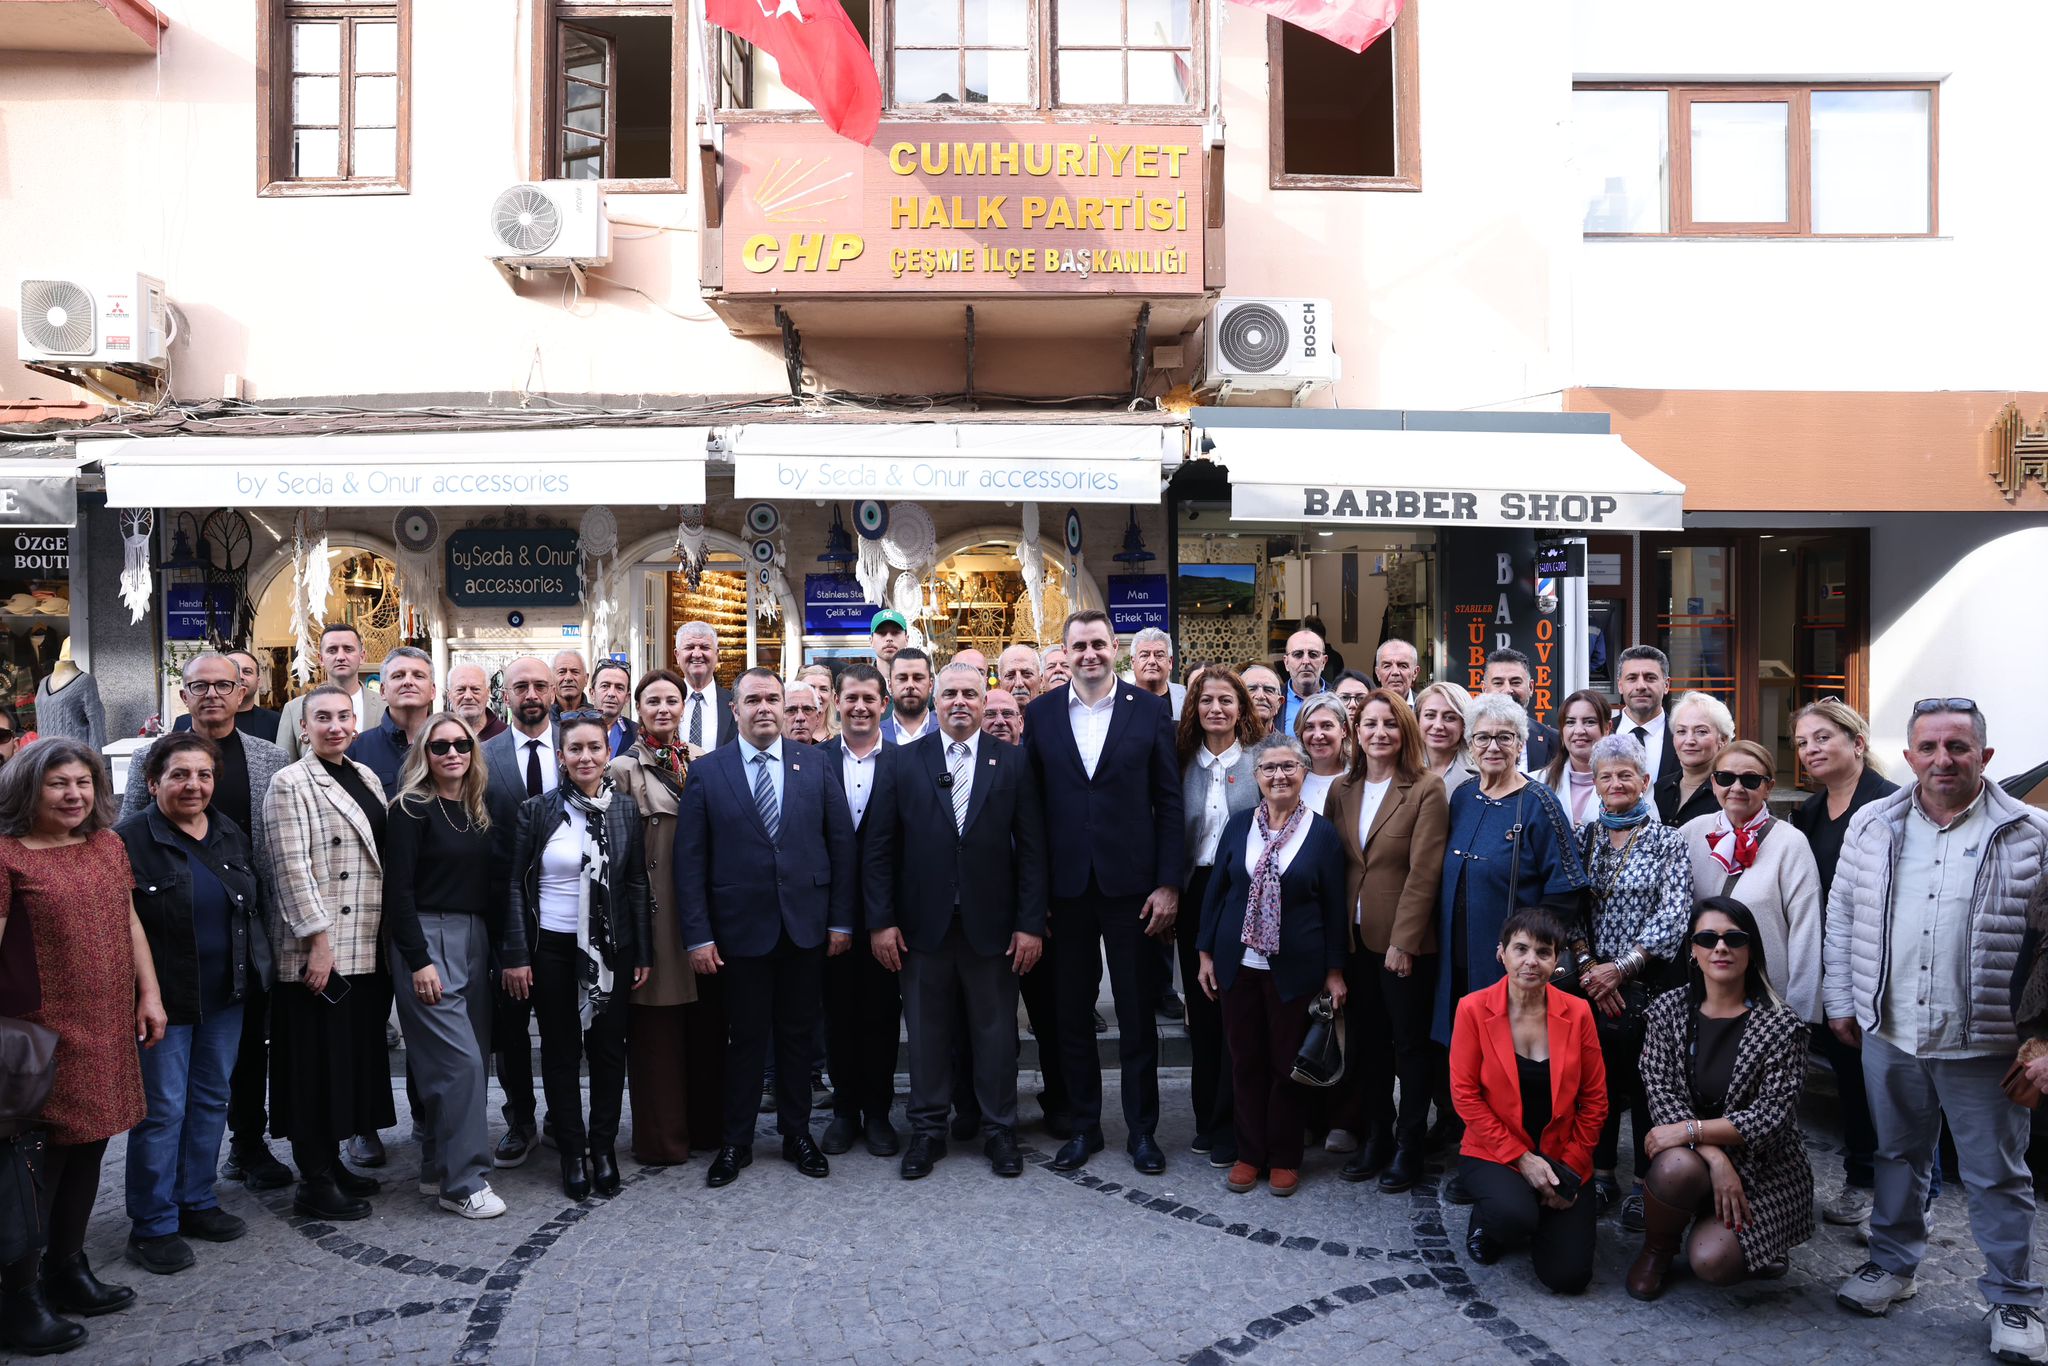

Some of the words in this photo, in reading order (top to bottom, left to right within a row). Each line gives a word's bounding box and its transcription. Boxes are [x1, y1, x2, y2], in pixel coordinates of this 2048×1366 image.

[889, 134, 1188, 177] CUMHURİYET
[891, 195, 1008, 229] HALK
[1022, 190, 1187, 231] PARTİSİ
[742, 233, 865, 273] CHP
[890, 247, 975, 278] ÇEŞME
[983, 243, 1036, 278] İLÇE
[1045, 245, 1187, 279] BAŞKANLIĞI
[1303, 303, 1316, 357] BOSCH
[237, 471, 267, 498] by
[277, 471, 333, 494] Seda
[342, 471, 359, 493] &
[368, 471, 422, 493] Onur
[432, 469, 569, 493] accessories
[778, 463, 808, 490] by
[818, 463, 876, 486] Seda
[886, 464, 903, 486] &
[913, 464, 970, 487] Onur
[979, 467, 1119, 490] accessories
[1303, 488, 1478, 520] BARBER
[1500, 493, 1617, 522] SHOP
[519, 545, 531, 566] &
[536, 545, 577, 566] Onur
[465, 576, 563, 594] accessories
[816, 590, 849, 599] Stainless
[1127, 590, 1149, 600] Man
[826, 608, 846, 618] Çelik
[1115, 612, 1142, 623] Erkek
[1144, 612, 1162, 622] Takı
[1455, 604, 1494, 613] STABILER
[182, 617, 190, 626] El
